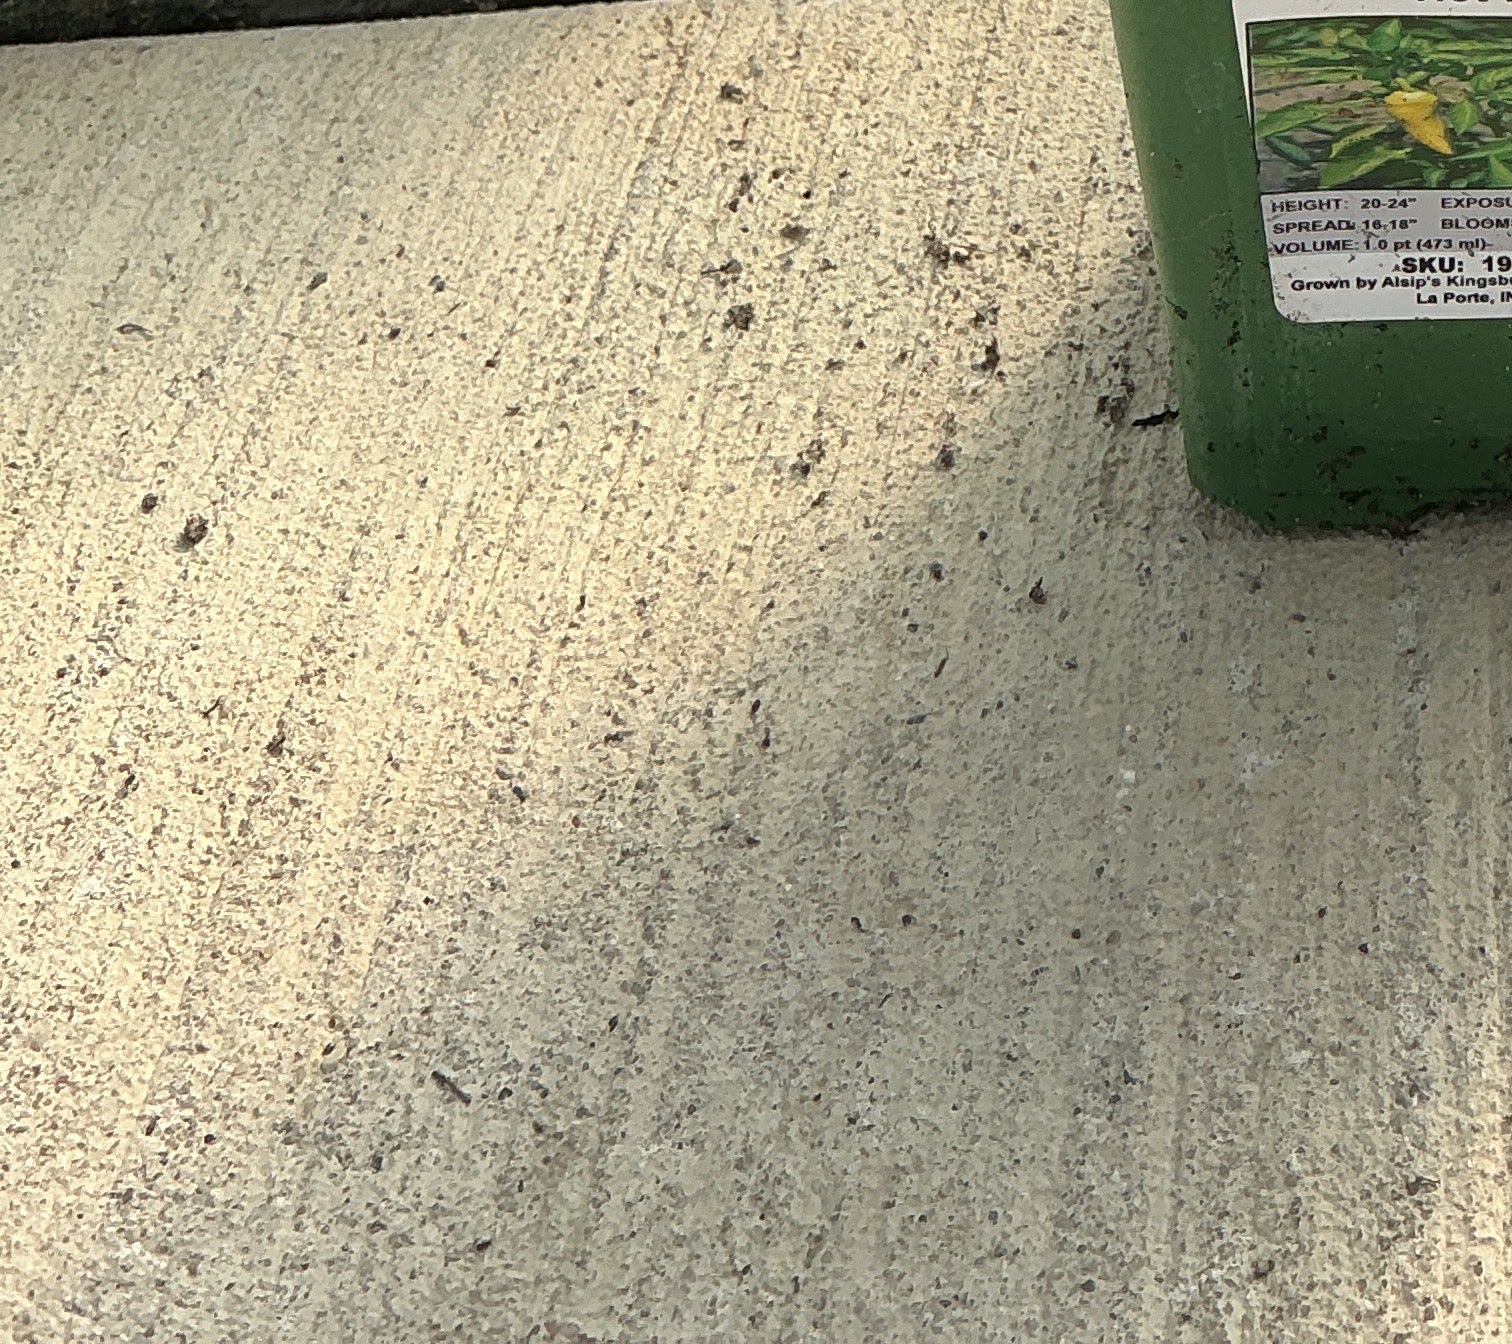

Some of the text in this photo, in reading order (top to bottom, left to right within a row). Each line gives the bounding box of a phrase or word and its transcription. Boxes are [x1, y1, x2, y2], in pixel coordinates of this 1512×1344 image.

[1271, 198, 1349, 213] HEIGHT:
[1273, 219, 1356, 235] SPREAD:
[1273, 240, 1360, 255] VOLUME:
[1363, 240, 1388, 251] 1.0
[1393, 240, 1412, 253] pt
[1416, 238, 1453, 252] (473
[1401, 256, 1464, 274] SKU:
[1291, 278, 1350, 291] Grown
[1356, 276, 1378, 291] by
[1382, 275, 1441, 290] Alsip's
[1416, 292, 1438, 305] La
[1443, 292, 1495, 306] Porte,
